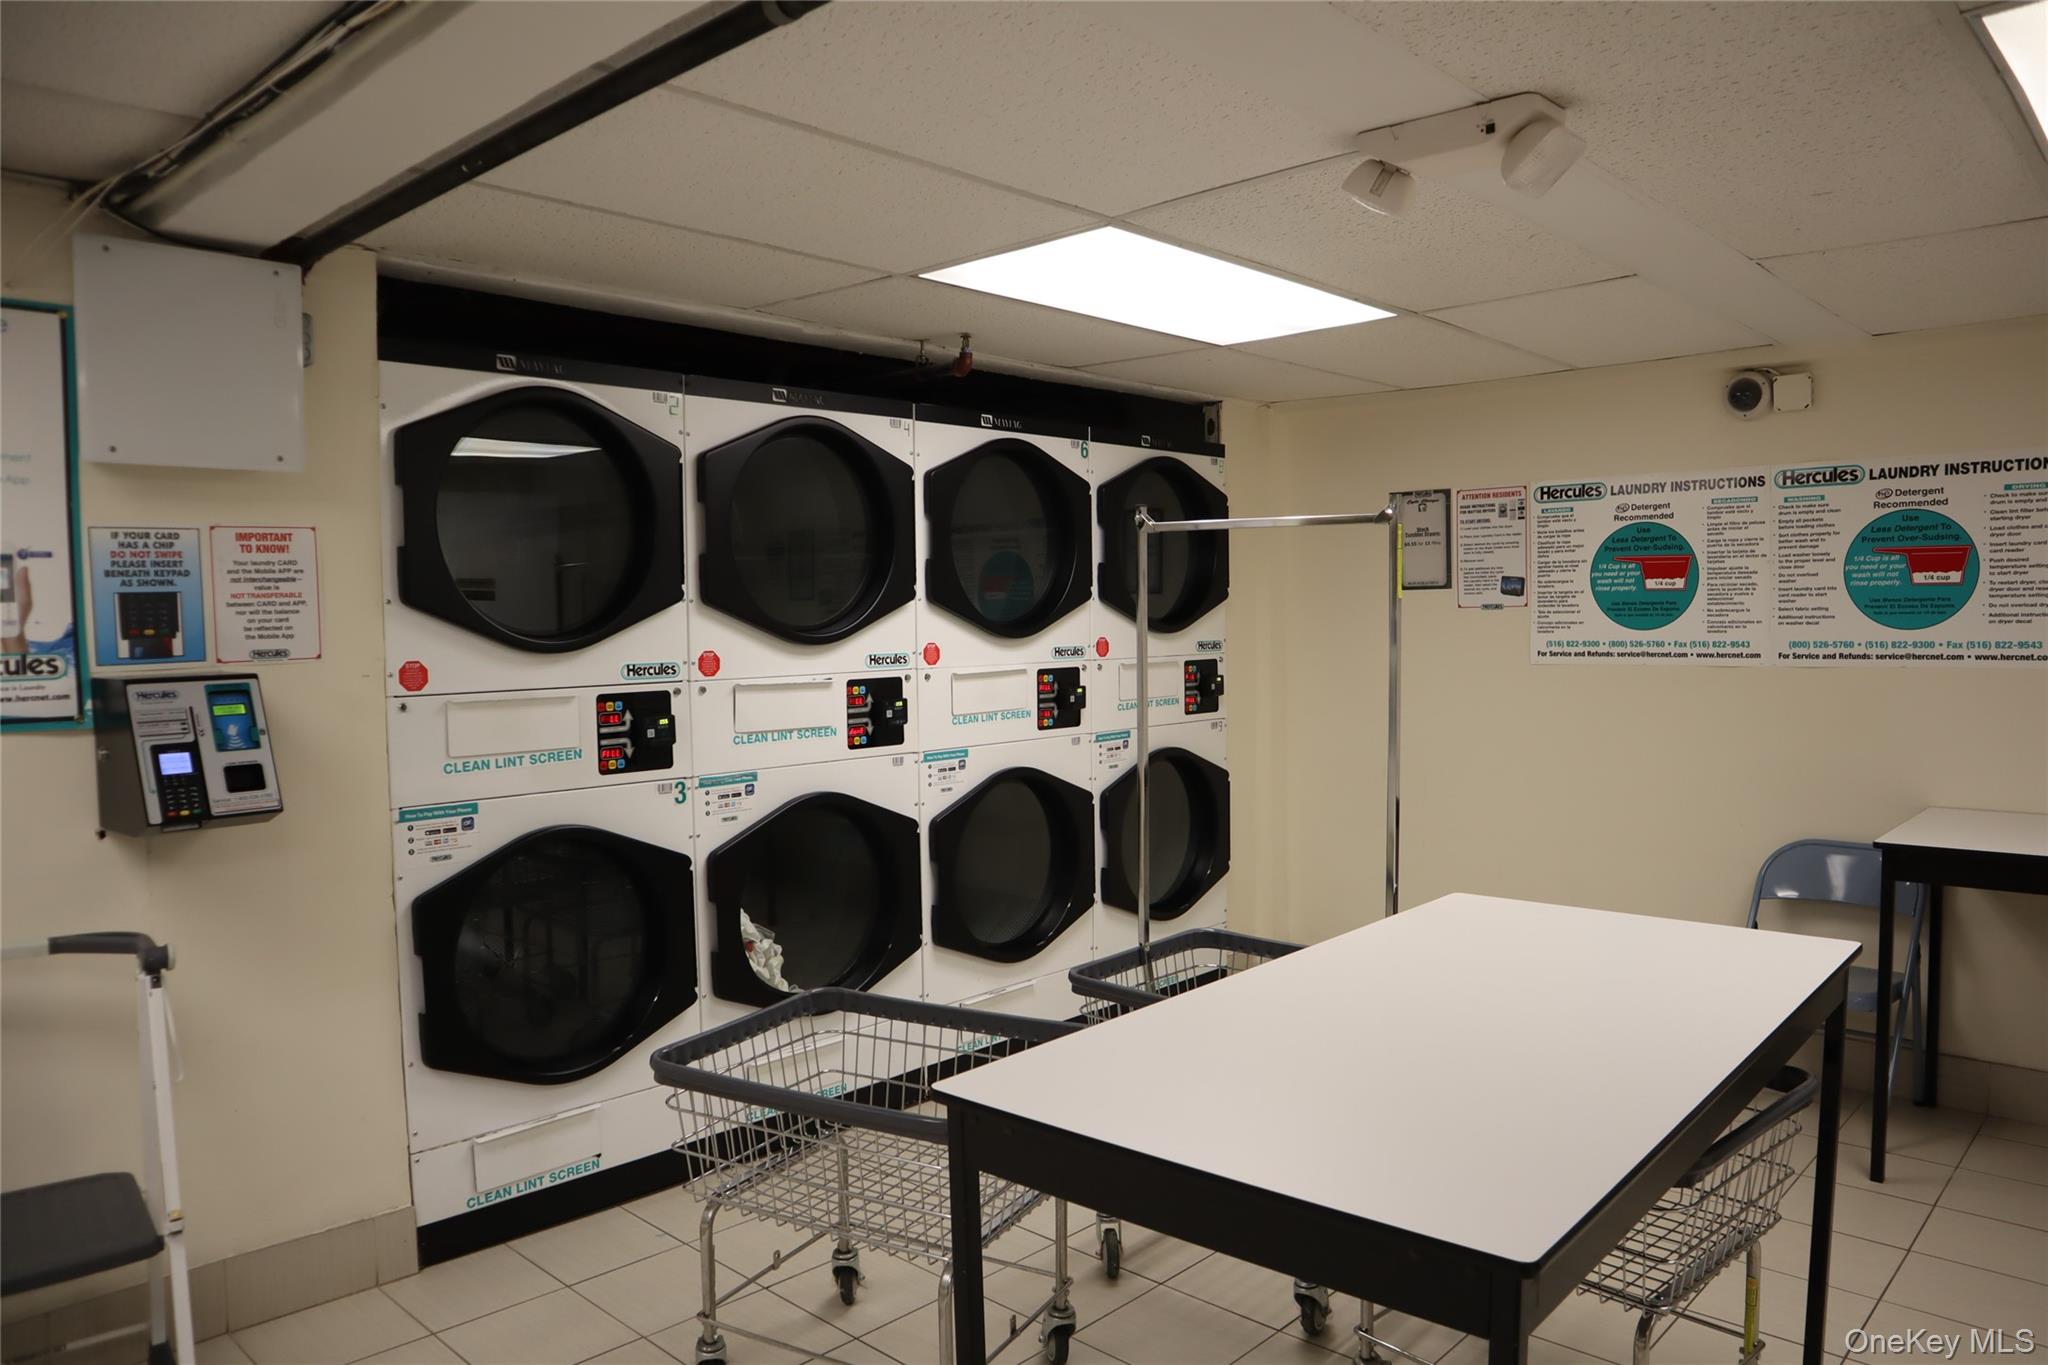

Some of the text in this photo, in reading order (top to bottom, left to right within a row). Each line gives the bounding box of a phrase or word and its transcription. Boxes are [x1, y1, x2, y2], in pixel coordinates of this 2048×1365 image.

[668, 395, 679, 416] 2
[1080, 440, 1088, 458] 6
[1782, 467, 1859, 486] Hercules
[1869, 462, 1940, 480] LAUNDRY
[1540, 475, 1766, 500] Hercules LAUNDRY INSTRUCTIONS
[1462, 492, 1491, 500] ATTENTION
[1895, 488, 1944, 498] Detergent
[1630, 502, 1671, 512] Detergent
[1874, 498, 1948, 509] Recommended
[1614, 512, 1674, 522] Recommended
[1894, 524, 1938, 533] Detergent
[110, 532, 180, 540] IF YOUR CARD
[235, 532, 293, 542] IMPORTANT
[1632, 536, 1664, 544] Detergent
[1898, 533, 1961, 542] Over-Sudsing.
[118, 541, 138, 549] HAS
[240, 545, 289, 554] TO KNOW!
[110, 550, 125, 559] DO
[1198, 641, 1222, 650] Hercules
[1546, 640, 1564, 648] (516)
[1608, 640, 1628, 648] (800)
[1690, 640, 1710, 648] (516)
[1789, 640, 1810, 650] (800)
[1813, 641, 1854, 649] 526-5760
[1865, 640, 1888, 650] (516)
[1891, 641, 1936, 649] 822-9300
[1966, 641, 1992, 650] (516)
[1995, 641, 2042, 649] 822-9543
[1054, 646, 1084, 658] Hercules
[1875, 653, 1964, 661] service@hercnet.com
[0, 654, 59, 676] ules
[869, 654, 907, 666] Hercules
[626, 663, 676, 678] Hercules
[136, 690, 176, 700] Hercules
[1117, 703, 1138, 711] CLEAN
[1155, 698, 1180, 707] SCREEN
[952, 709, 1031, 726] CLEAN LINT SCREEN
[733, 733, 768, 745] CLEAN
[771, 730, 793, 741] LINT
[797, 728, 837, 740] SCREEN
[443, 749, 582, 775] CLEAN LINT SCREEN
[674, 781, 686, 803] 3
[816, 1082, 847, 1096] REEN
[466, 1159, 600, 1210] CLEAN LINT SCREEN
